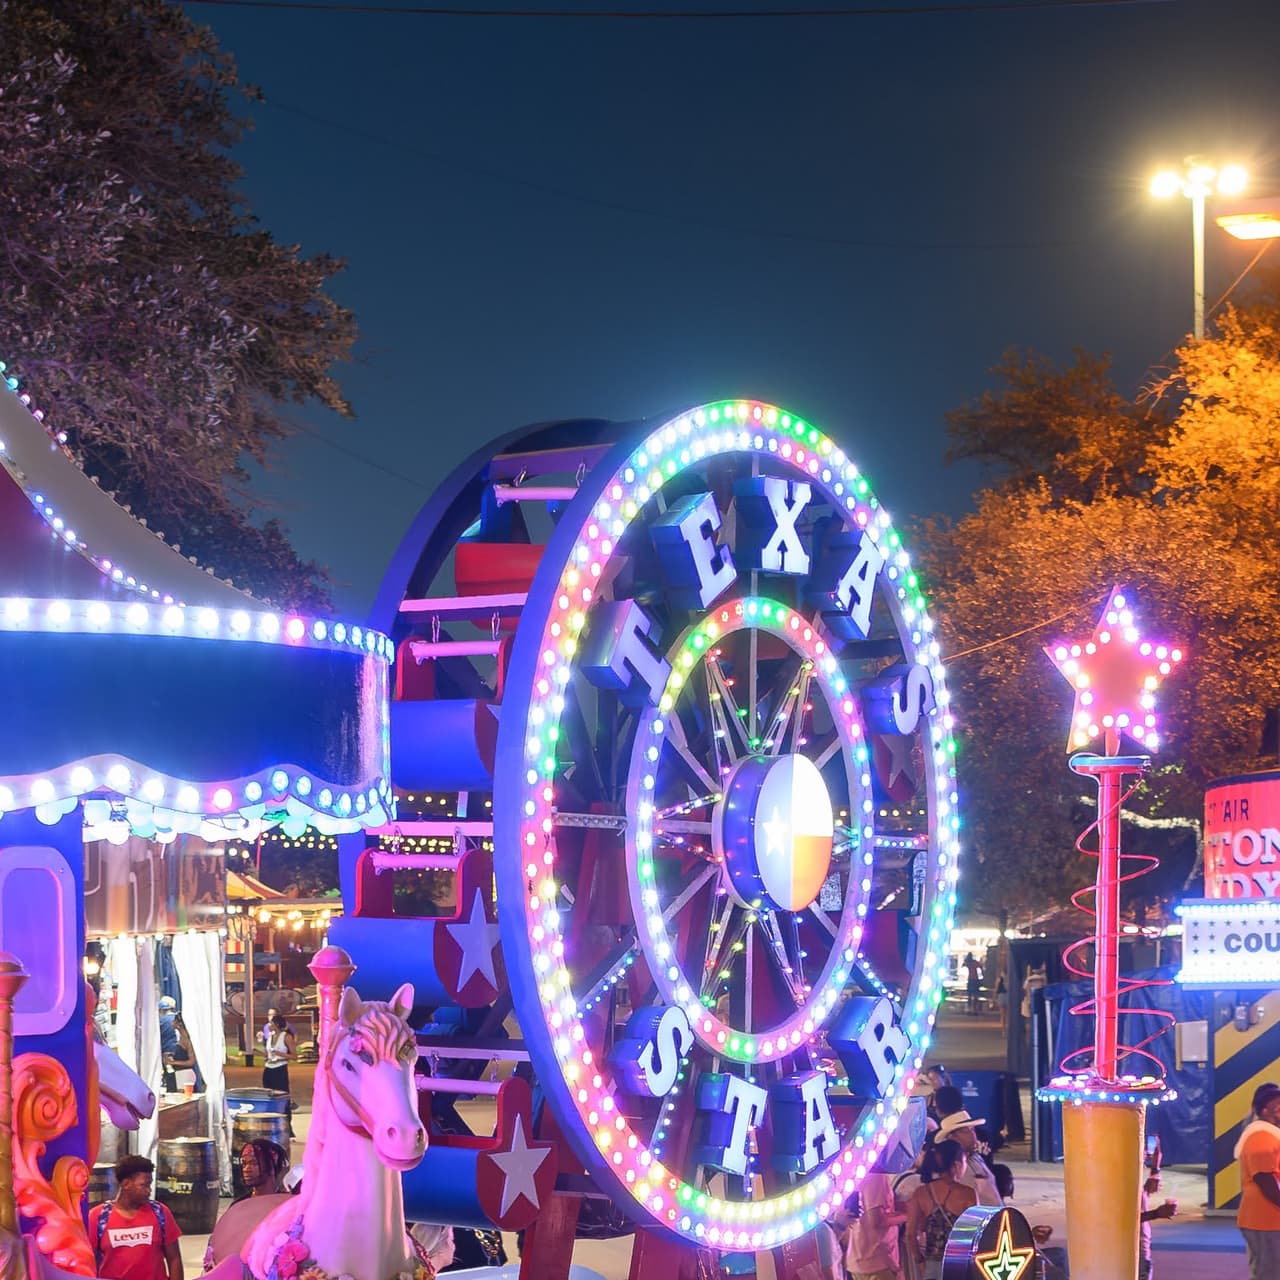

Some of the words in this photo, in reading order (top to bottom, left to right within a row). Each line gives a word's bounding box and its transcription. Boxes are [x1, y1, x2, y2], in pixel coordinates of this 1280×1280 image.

[608, 476, 939, 735] TEXAS
[1218, 798, 1250, 822] AIR
[637, 998, 912, 1176] STAR
